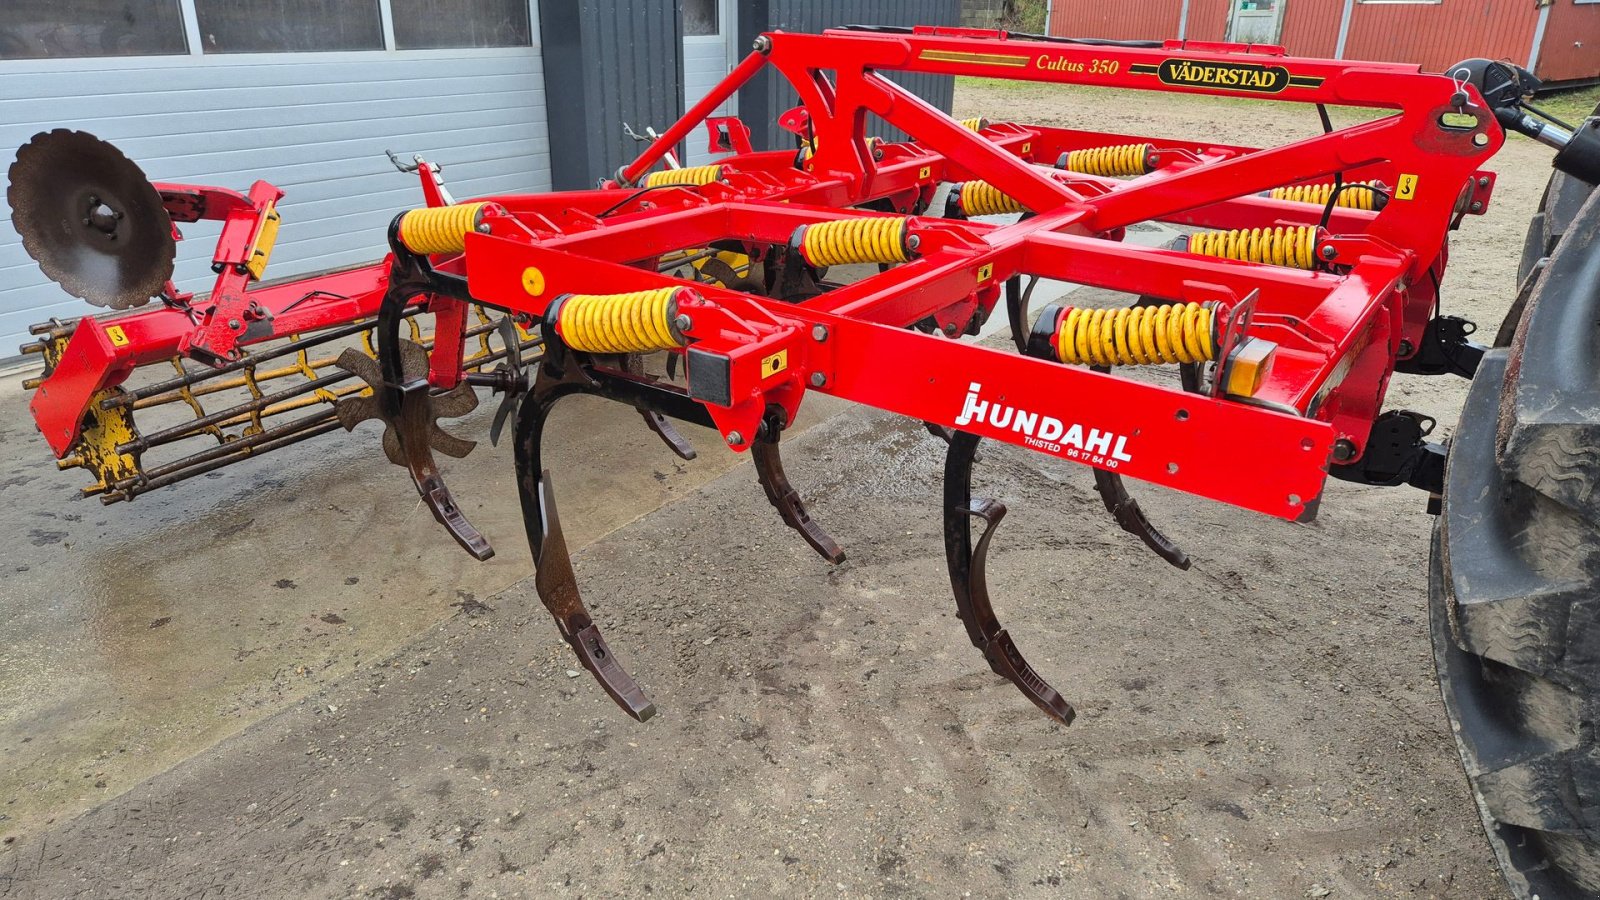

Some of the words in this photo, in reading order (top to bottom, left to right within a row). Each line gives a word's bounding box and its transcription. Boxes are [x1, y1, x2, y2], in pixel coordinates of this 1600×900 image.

[1036, 54, 1084, 74] Cultus
[1089, 59, 1119, 75] 350
[1169, 61, 1278, 87] VÄDERSTAD
[1024, 436, 1061, 452] THISTED
[1067, 448, 1078, 458] 96
[1081, 452, 1090, 461] 17
[1092, 455, 1103, 464] 84
[1106, 459, 1118, 468] 00
